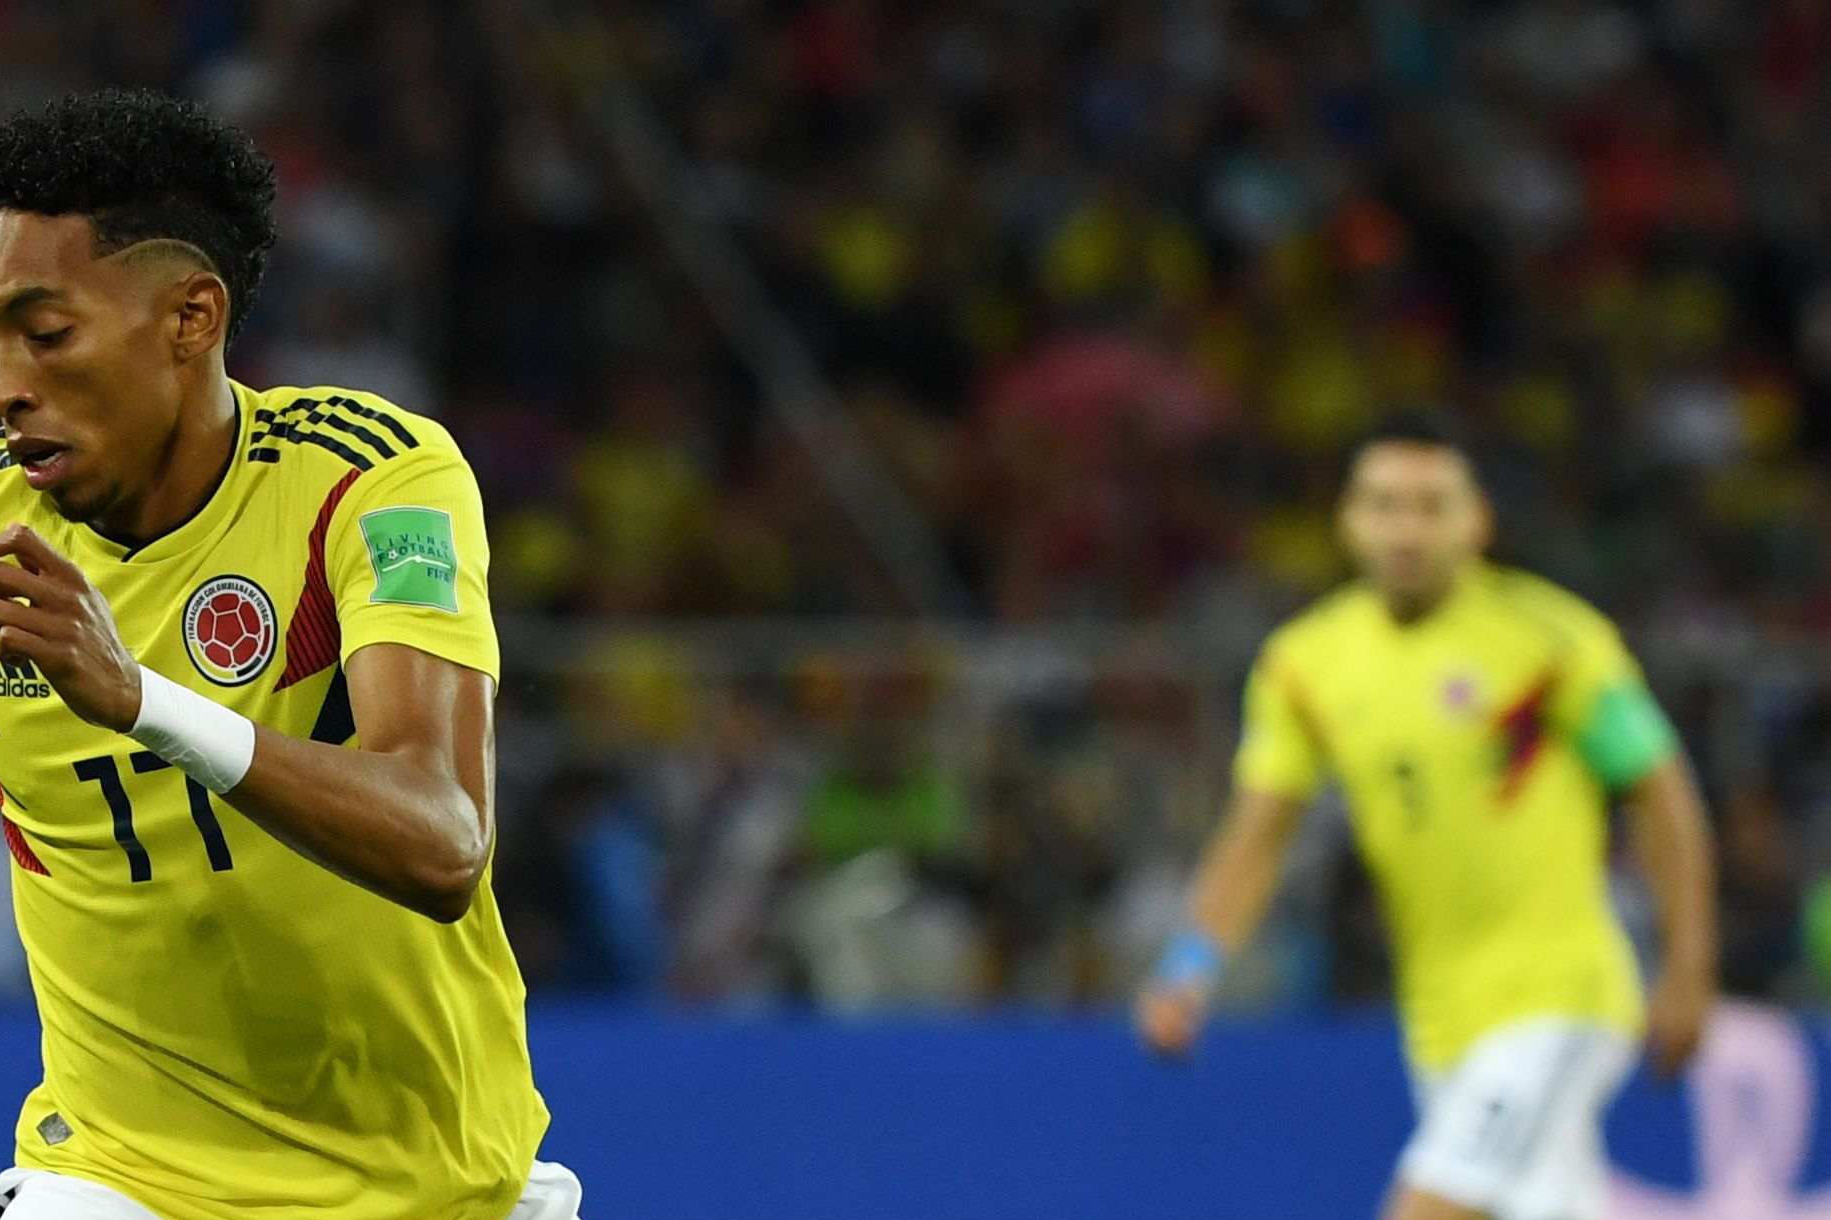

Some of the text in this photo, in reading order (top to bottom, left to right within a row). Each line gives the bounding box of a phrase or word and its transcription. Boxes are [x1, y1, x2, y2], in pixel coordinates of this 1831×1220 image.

[375, 533, 449, 552] LIVING
[426, 566, 450, 584] FIFA
[72, 750, 235, 883] 17
